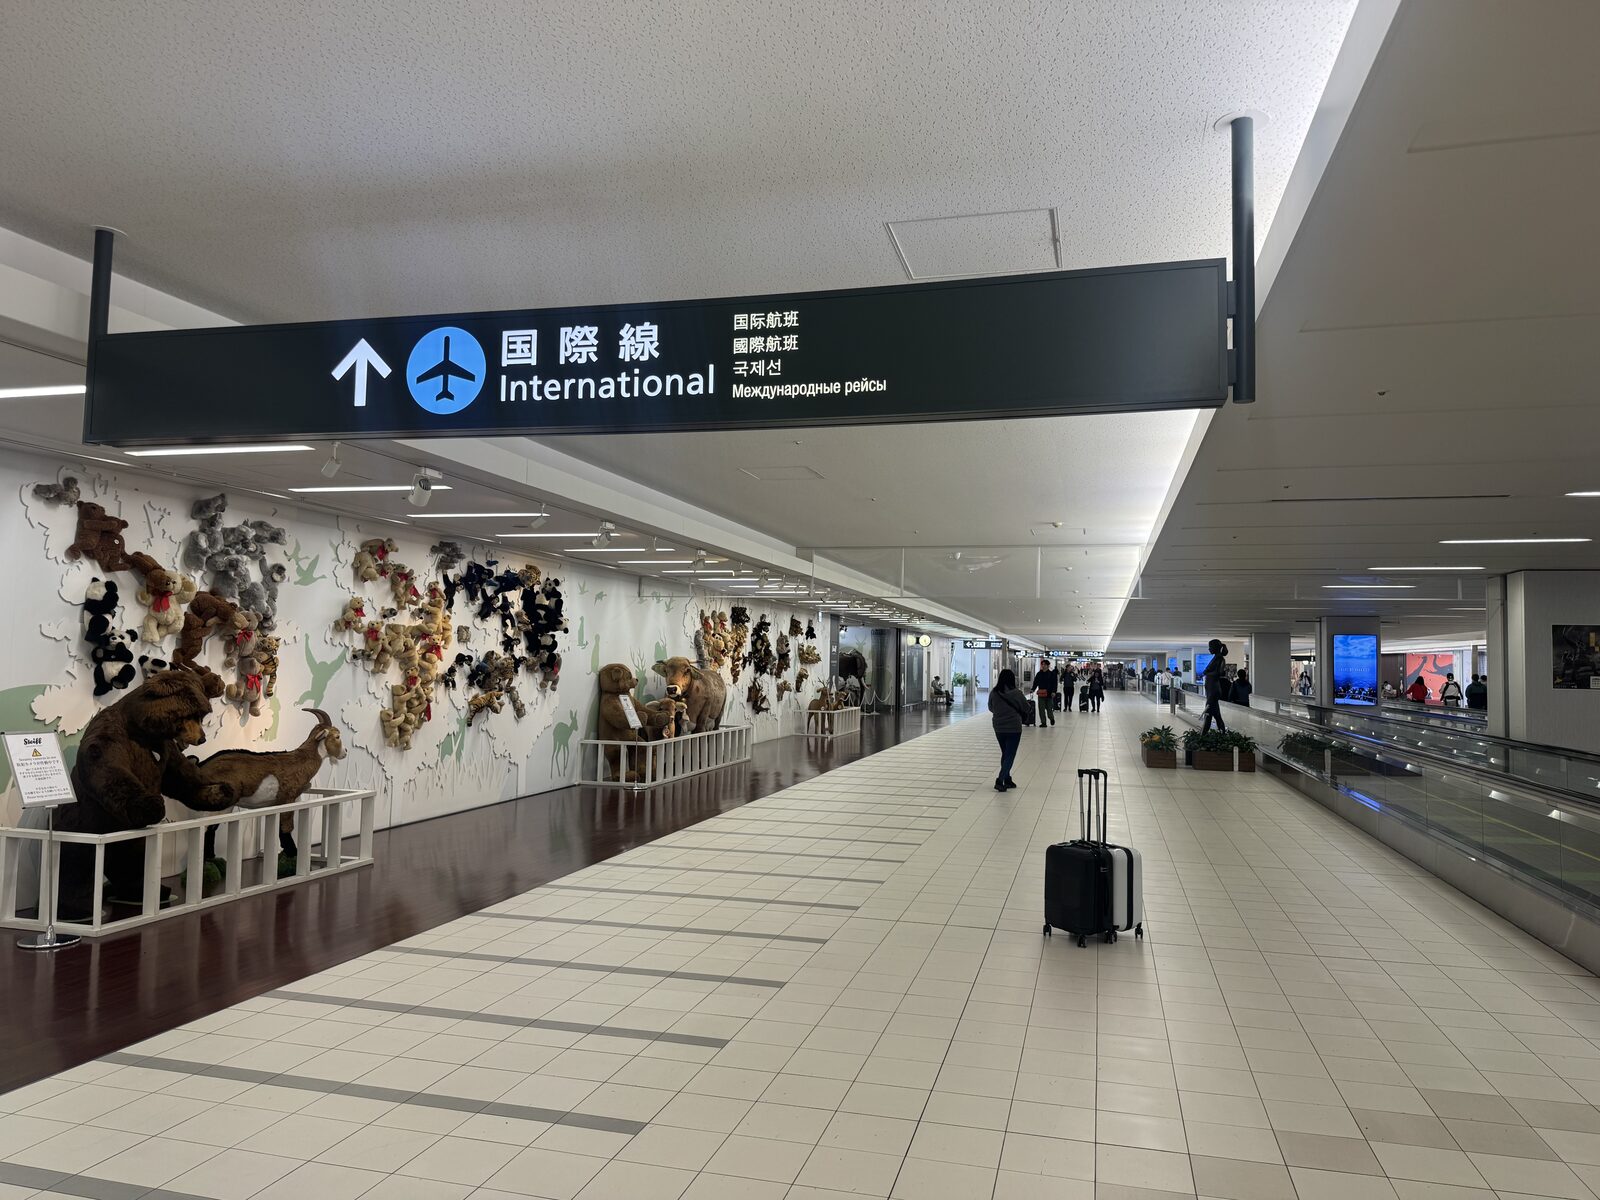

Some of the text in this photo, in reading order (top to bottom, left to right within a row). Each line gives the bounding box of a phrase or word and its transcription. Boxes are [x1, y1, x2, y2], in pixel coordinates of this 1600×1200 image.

[733, 310, 799, 331] 国际航班
[501, 322, 660, 367] 国際線
[733, 334, 799, 354] 國際航班
[732, 358, 782, 377] 국제선
[500, 363, 715, 402] International
[732, 377, 887, 400] Международные рейсы
